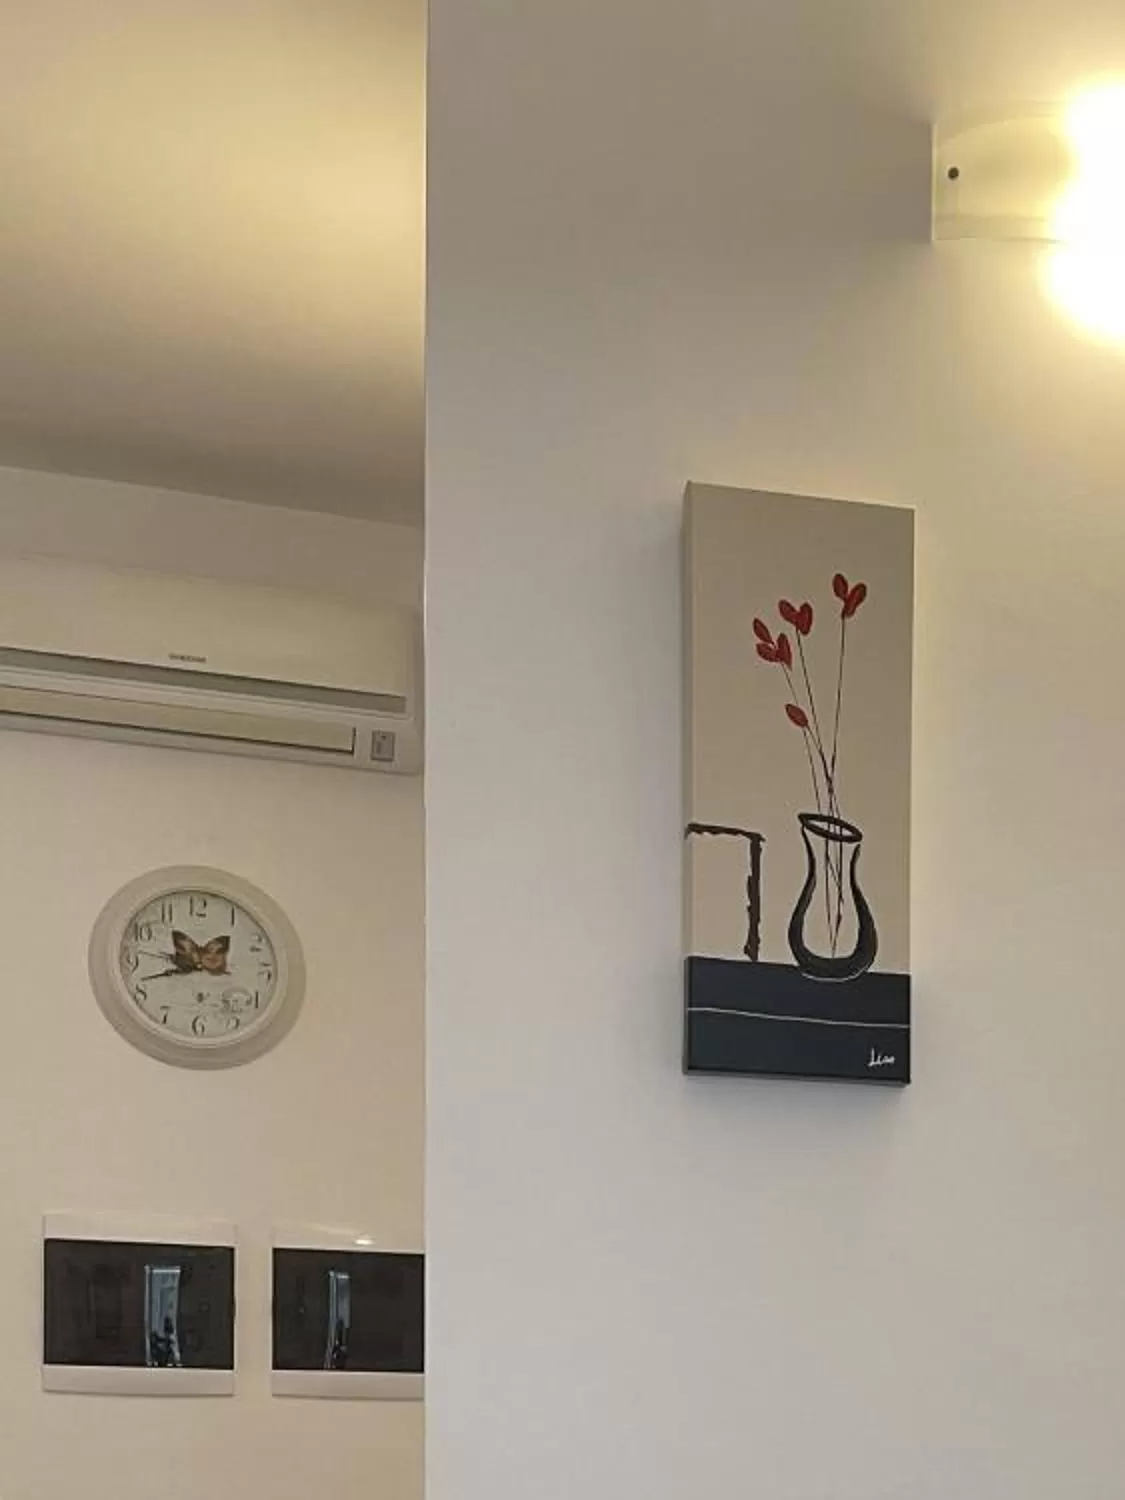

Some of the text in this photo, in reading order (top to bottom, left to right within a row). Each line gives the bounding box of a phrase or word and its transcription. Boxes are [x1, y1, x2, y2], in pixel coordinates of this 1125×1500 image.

[161, 902, 173, 923] 11
[188, 895, 207, 918] 12
[133, 921, 153, 942] 10
[249, 931, 263, 952] 2
[133, 983, 148, 1006] 8
[159, 1005, 171, 1025] 7
[191, 1014, 206, 1036] 6
